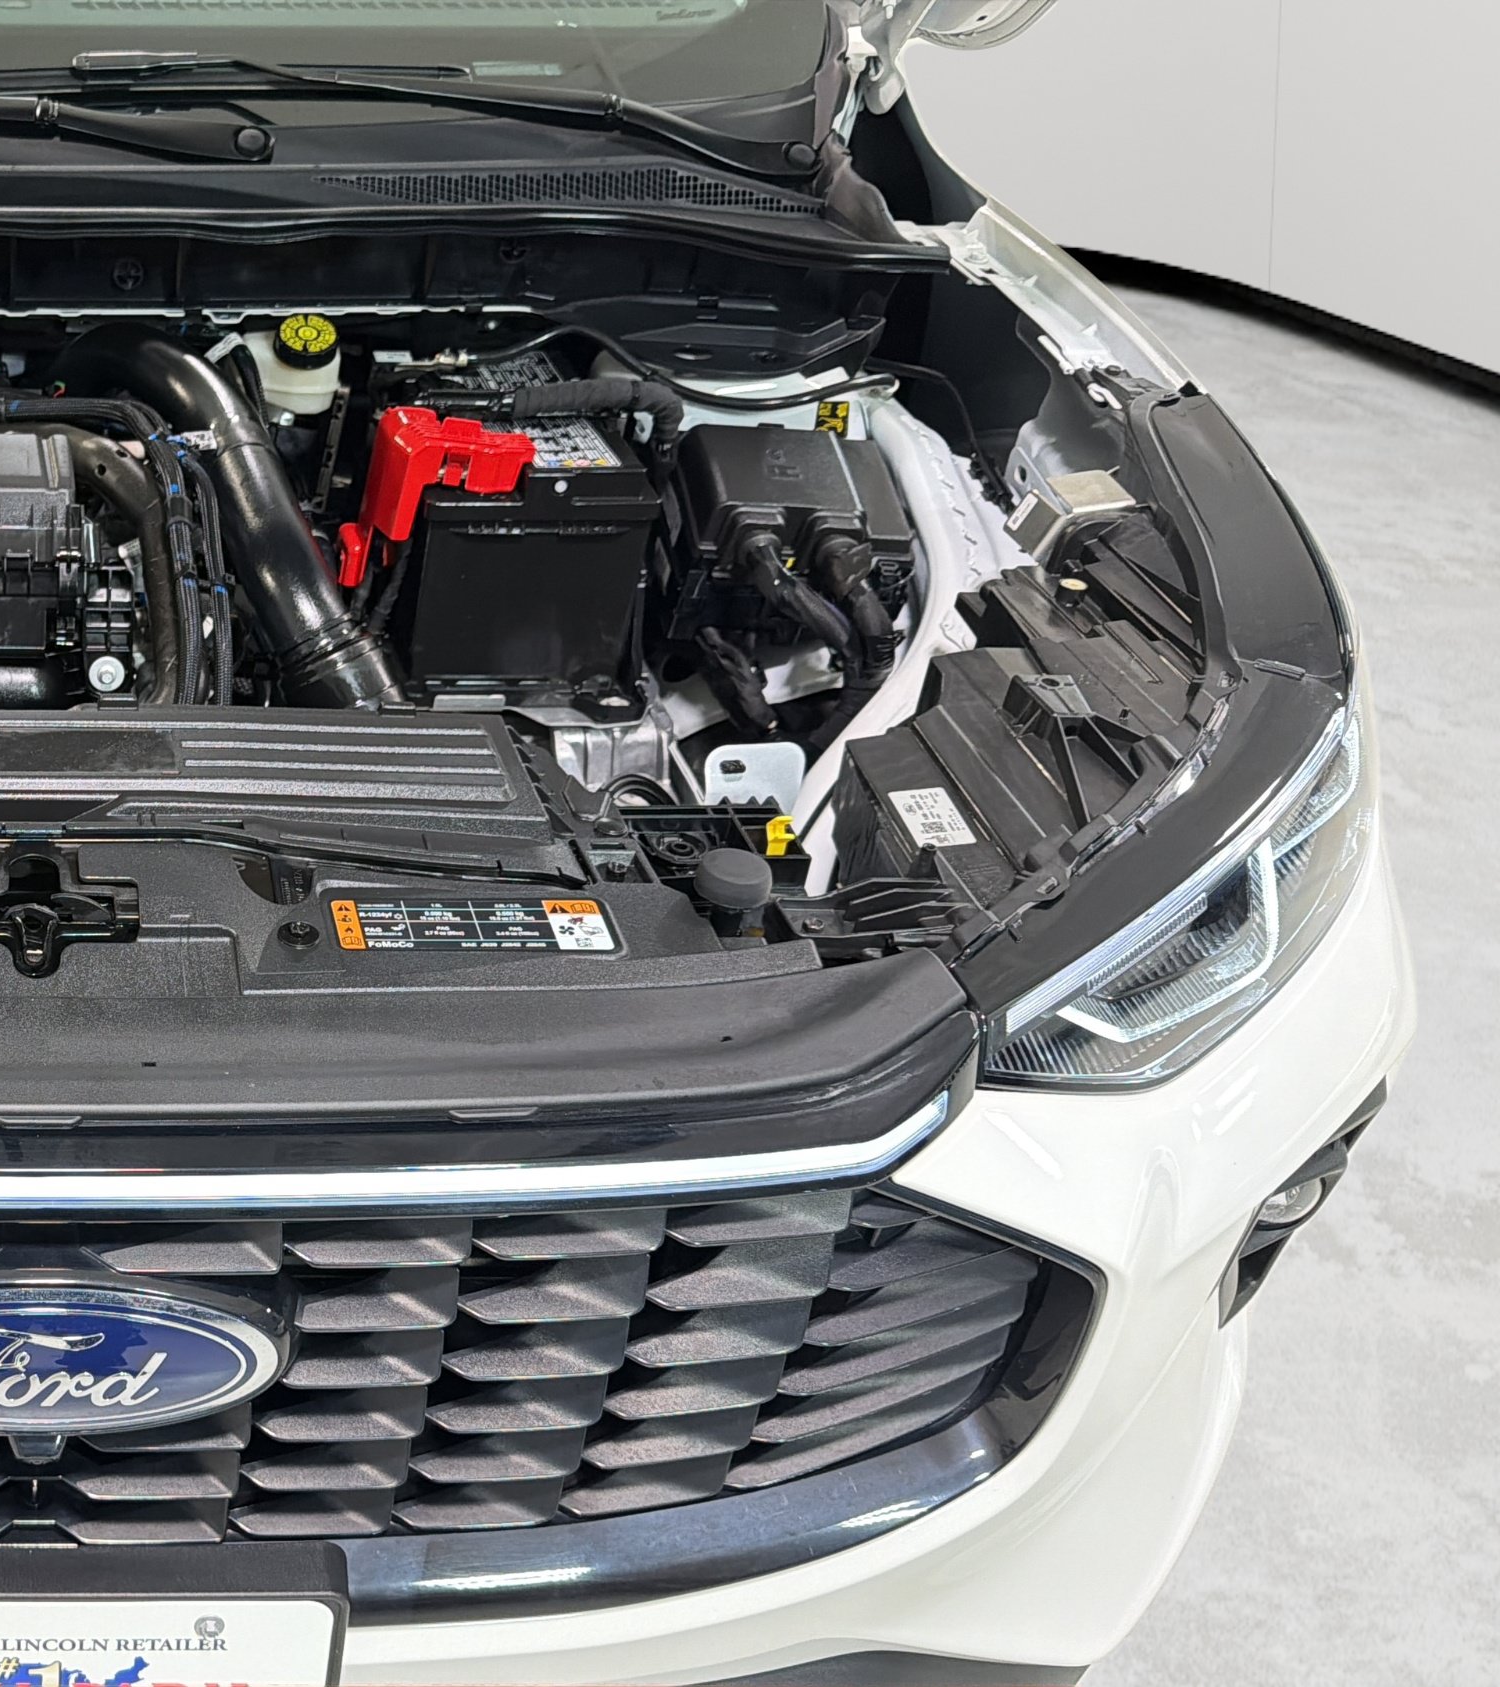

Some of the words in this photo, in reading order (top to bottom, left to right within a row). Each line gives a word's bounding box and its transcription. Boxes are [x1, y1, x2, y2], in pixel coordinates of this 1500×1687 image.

[368, 941, 414, 949] FoMoCo
[0, 1637, 110, 1651] LINCOLN
[114, 1638, 229, 1651] RETAILER
